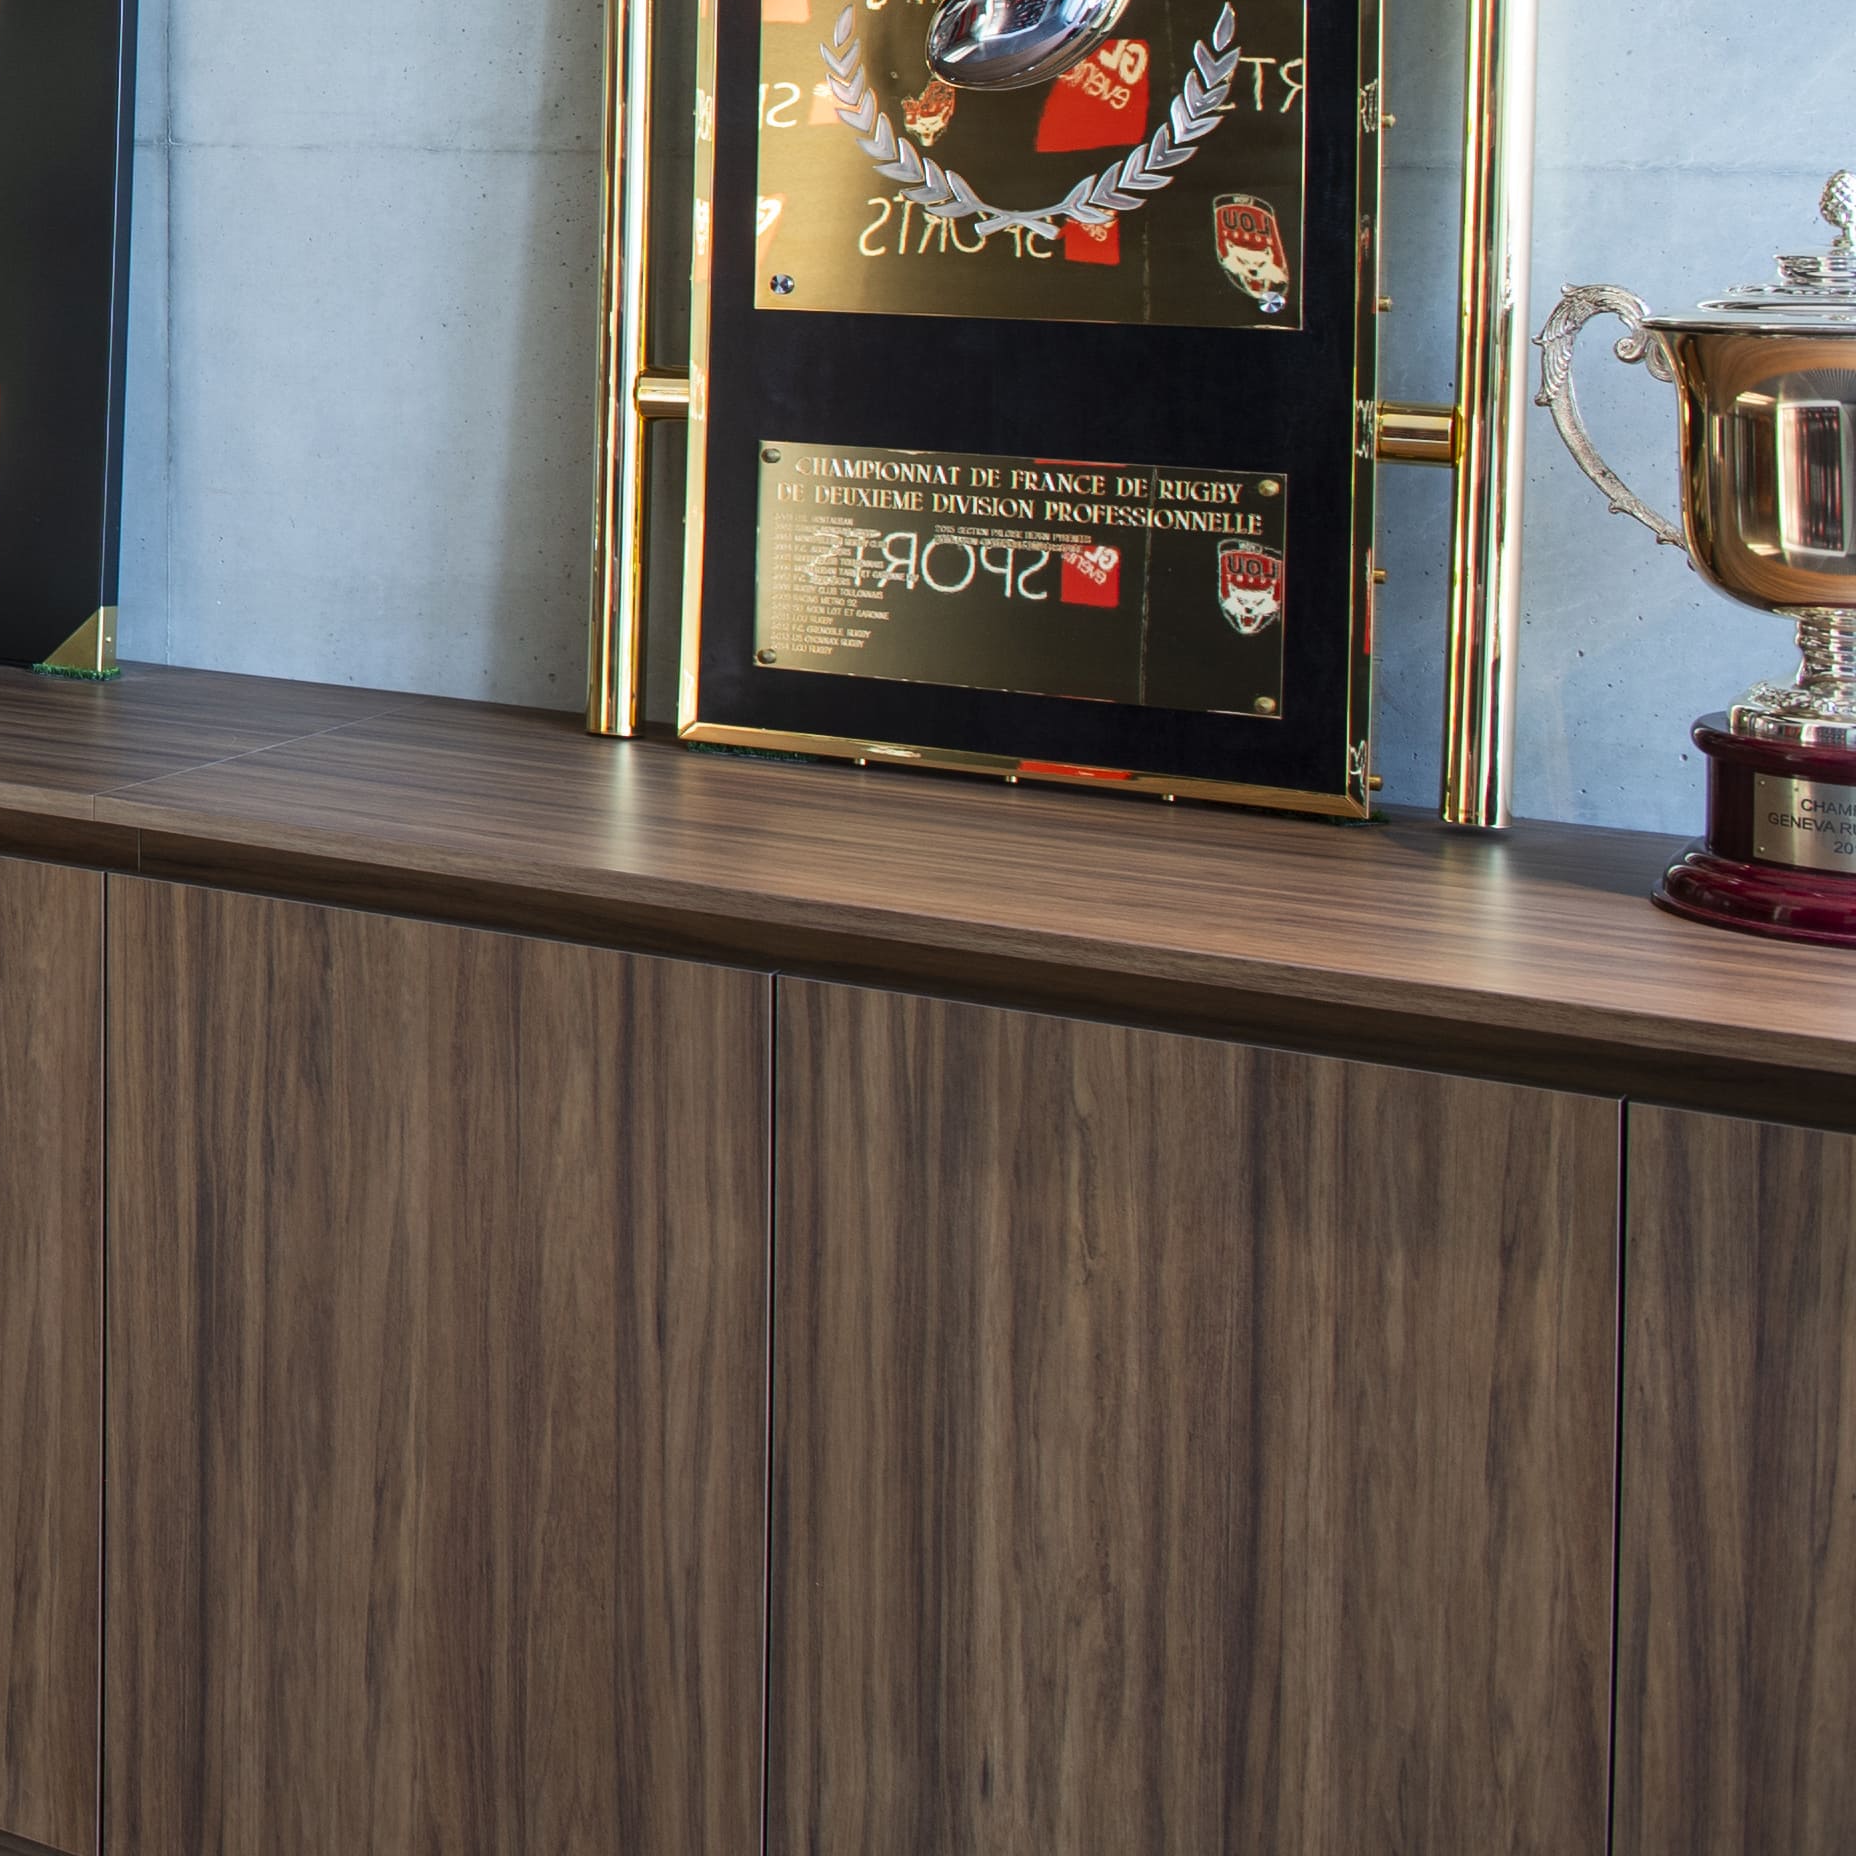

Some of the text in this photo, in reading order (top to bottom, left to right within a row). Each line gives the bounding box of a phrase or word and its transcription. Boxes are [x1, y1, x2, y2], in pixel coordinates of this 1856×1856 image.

[796, 456, 1243, 505] CHAMPIONNAT DE FRANCE DE RUGBY
[777, 482, 1263, 536] DE DEUXIEME DIVISION PROFESSIONNELLE
[1768, 812, 1836, 834] GENEVA
